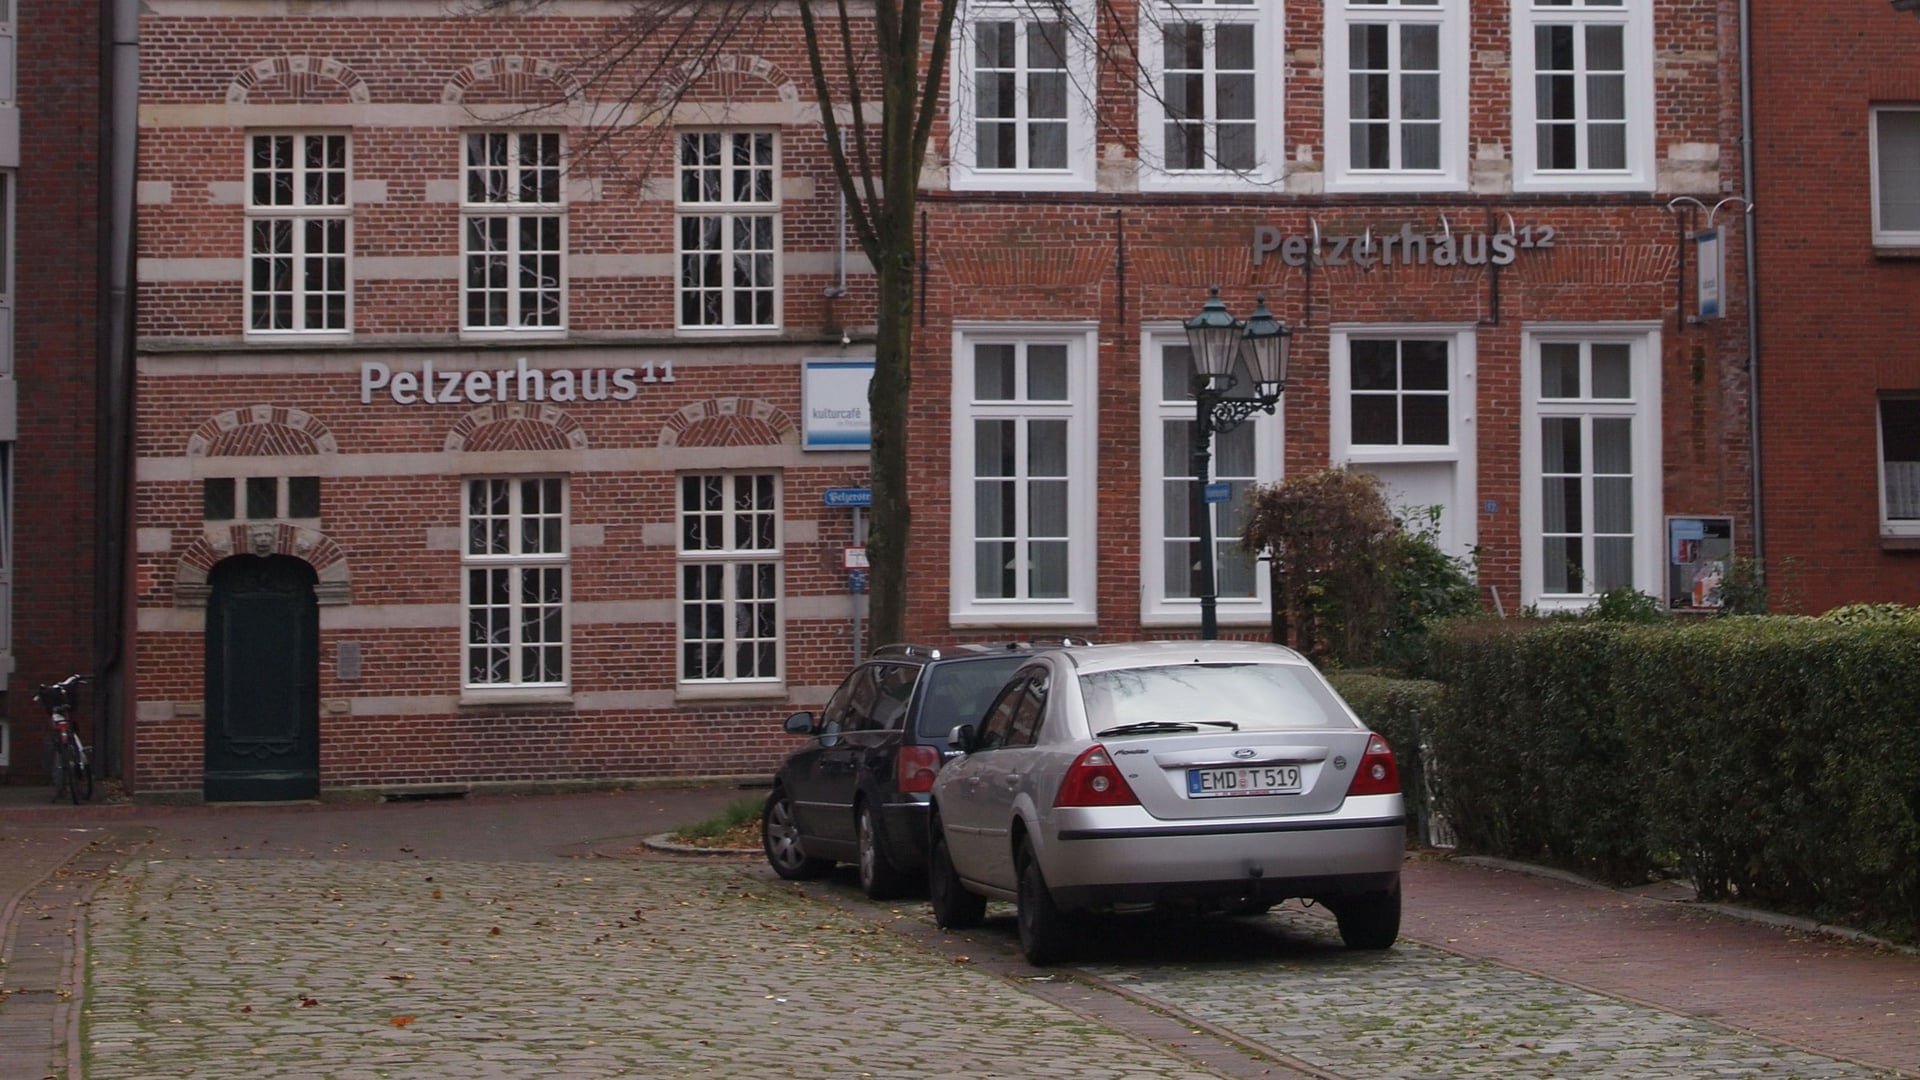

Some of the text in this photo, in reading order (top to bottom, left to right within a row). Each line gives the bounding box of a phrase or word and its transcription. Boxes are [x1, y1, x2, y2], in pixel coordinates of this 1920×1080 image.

[812, 407, 862, 419] kulturcafé
[1201, 768, 1299, 790] EMD T 519
